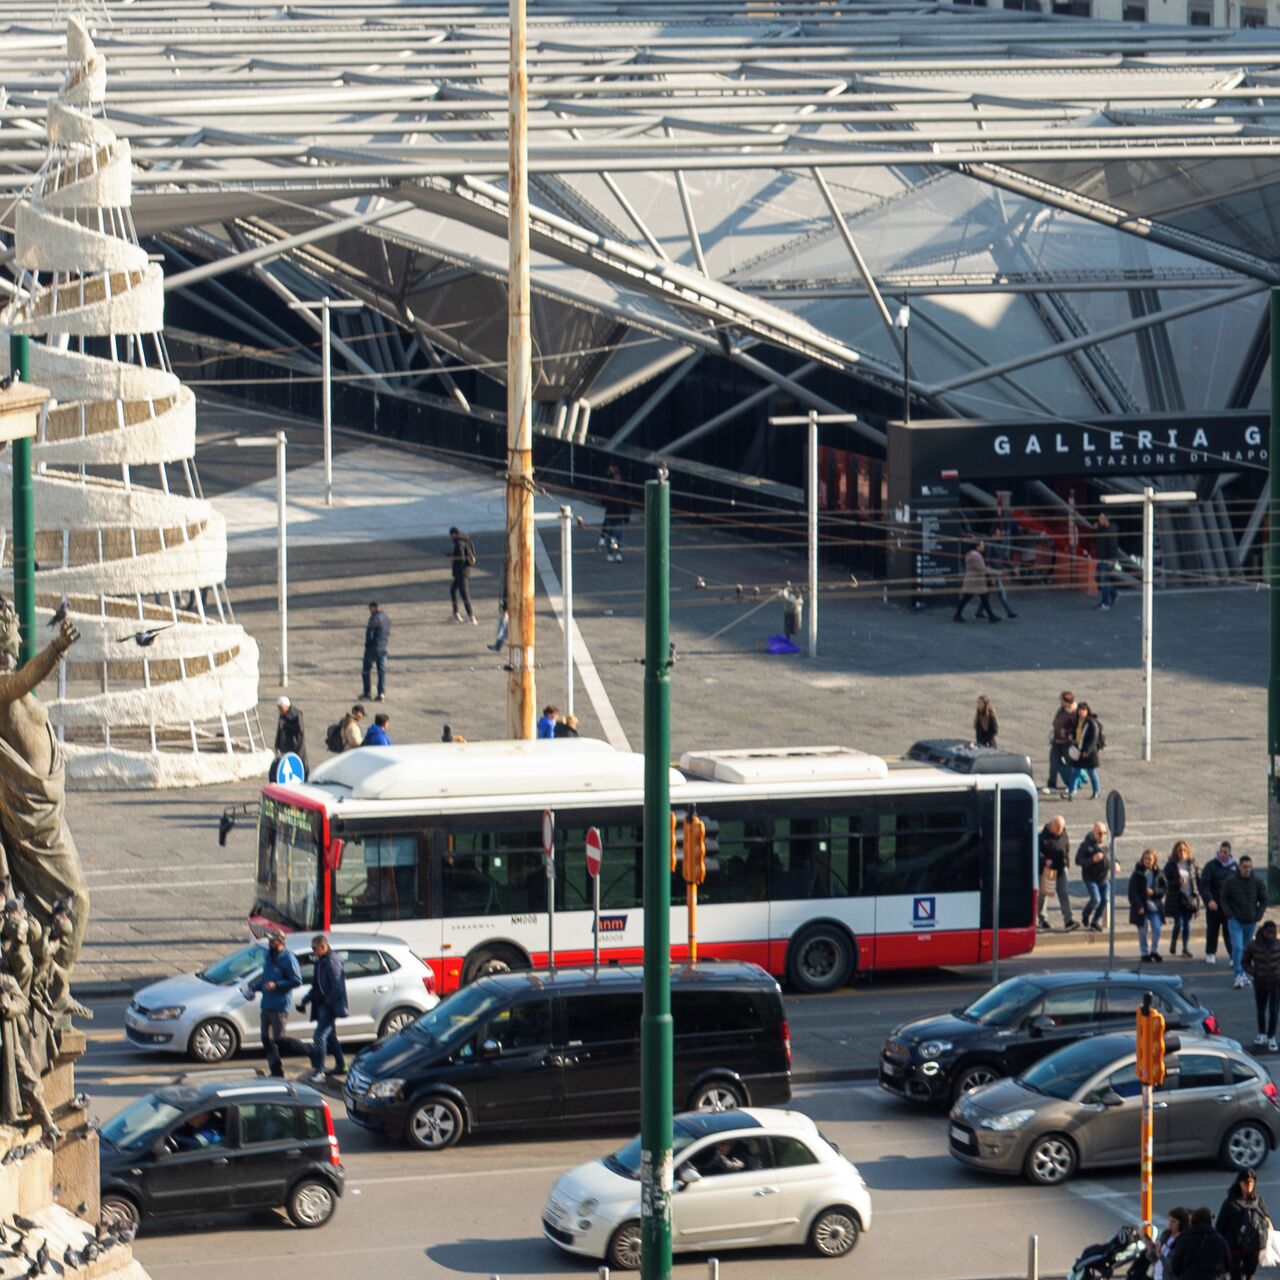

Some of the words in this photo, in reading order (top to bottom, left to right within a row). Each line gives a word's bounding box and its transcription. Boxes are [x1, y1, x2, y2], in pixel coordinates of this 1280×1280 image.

[993, 427, 1209, 456] GALLERIA
[1084, 452, 1177, 467] STAZIONE
[1189, 451, 1209, 463] DI
[1222, 448, 1270, 462] NAPO
